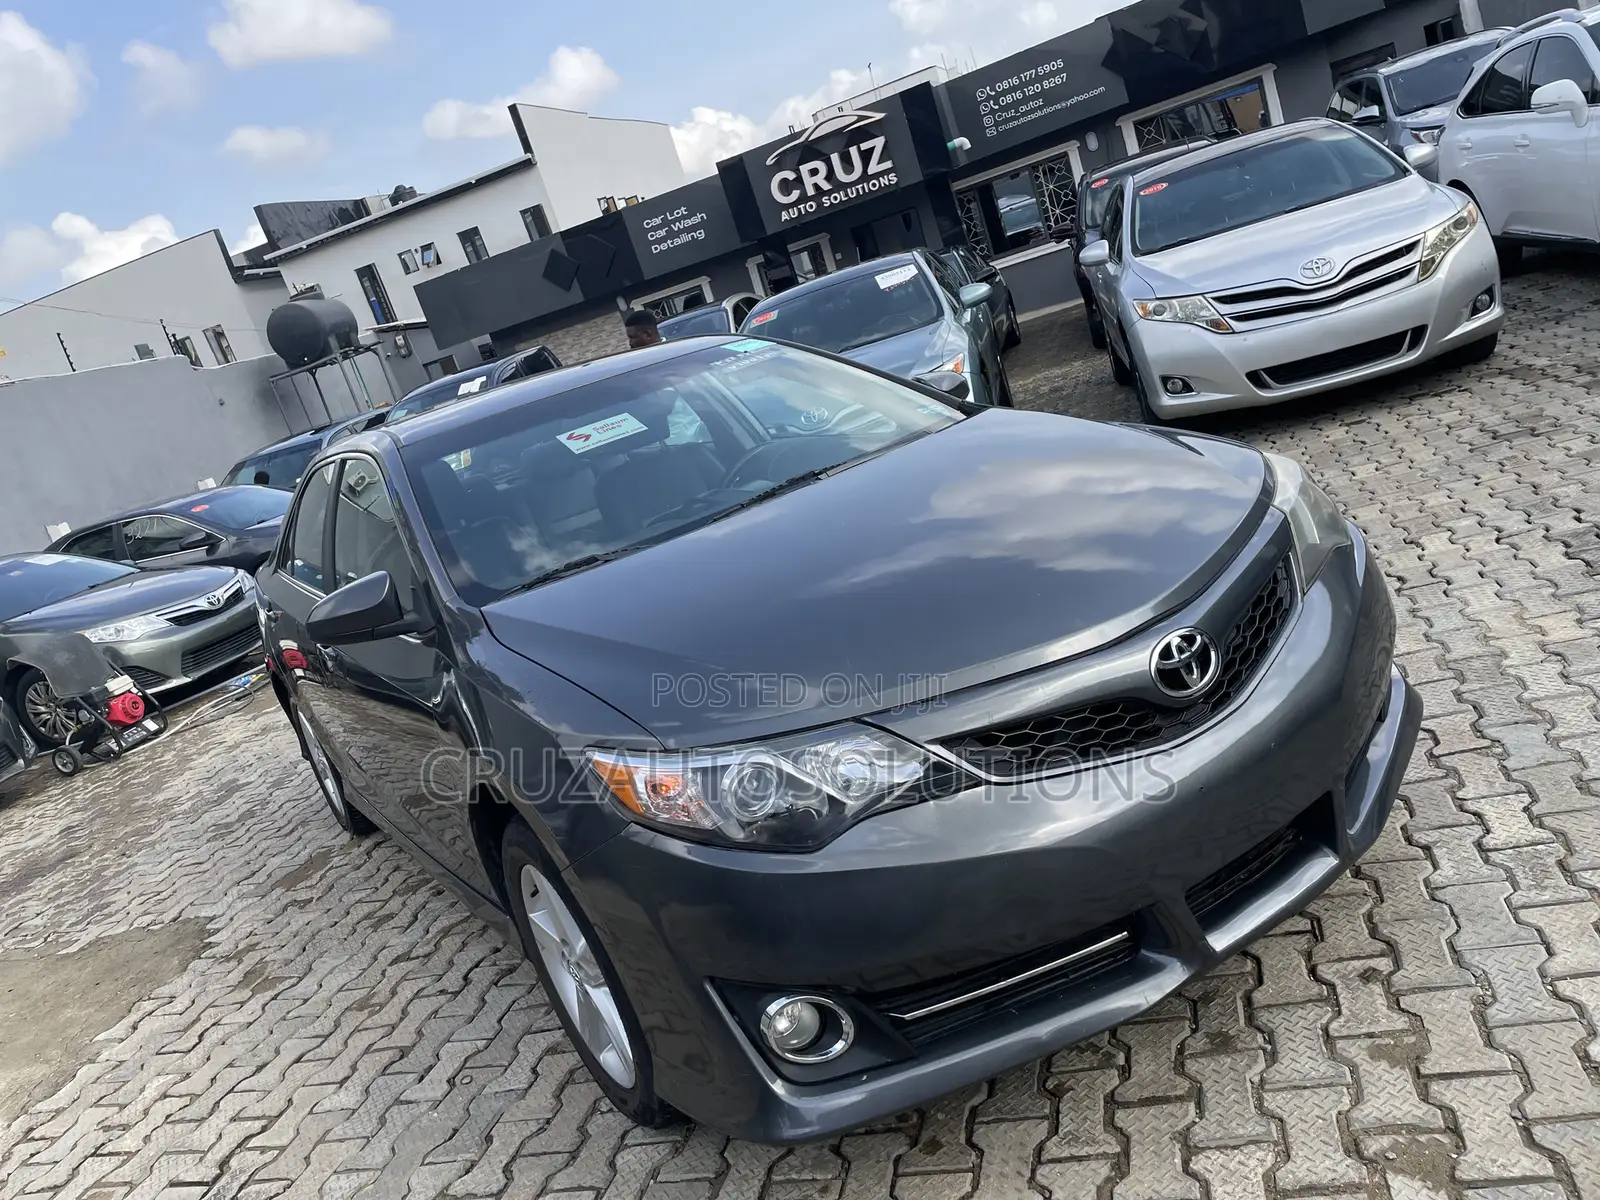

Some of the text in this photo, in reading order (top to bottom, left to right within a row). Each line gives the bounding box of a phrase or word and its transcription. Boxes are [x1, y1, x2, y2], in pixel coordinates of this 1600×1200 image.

[996, 59, 1063, 92] 0816 177 5905
[999, 73, 1067, 106] 0816 120 8267
[995, 98, 1044, 121] Cruz_autoz
[998, 86, 1106, 132] cruzautozsolutions@yahoo.com
[770, 135, 894, 205] CRUZ
[780, 172, 899, 222] AUTO SOLUTIONS
[643, 206, 689, 229] Car Lot
[647, 212, 707, 241] Car Wash
[651, 229, 706, 254] Detailing
[597, 424, 622, 435] Lines
